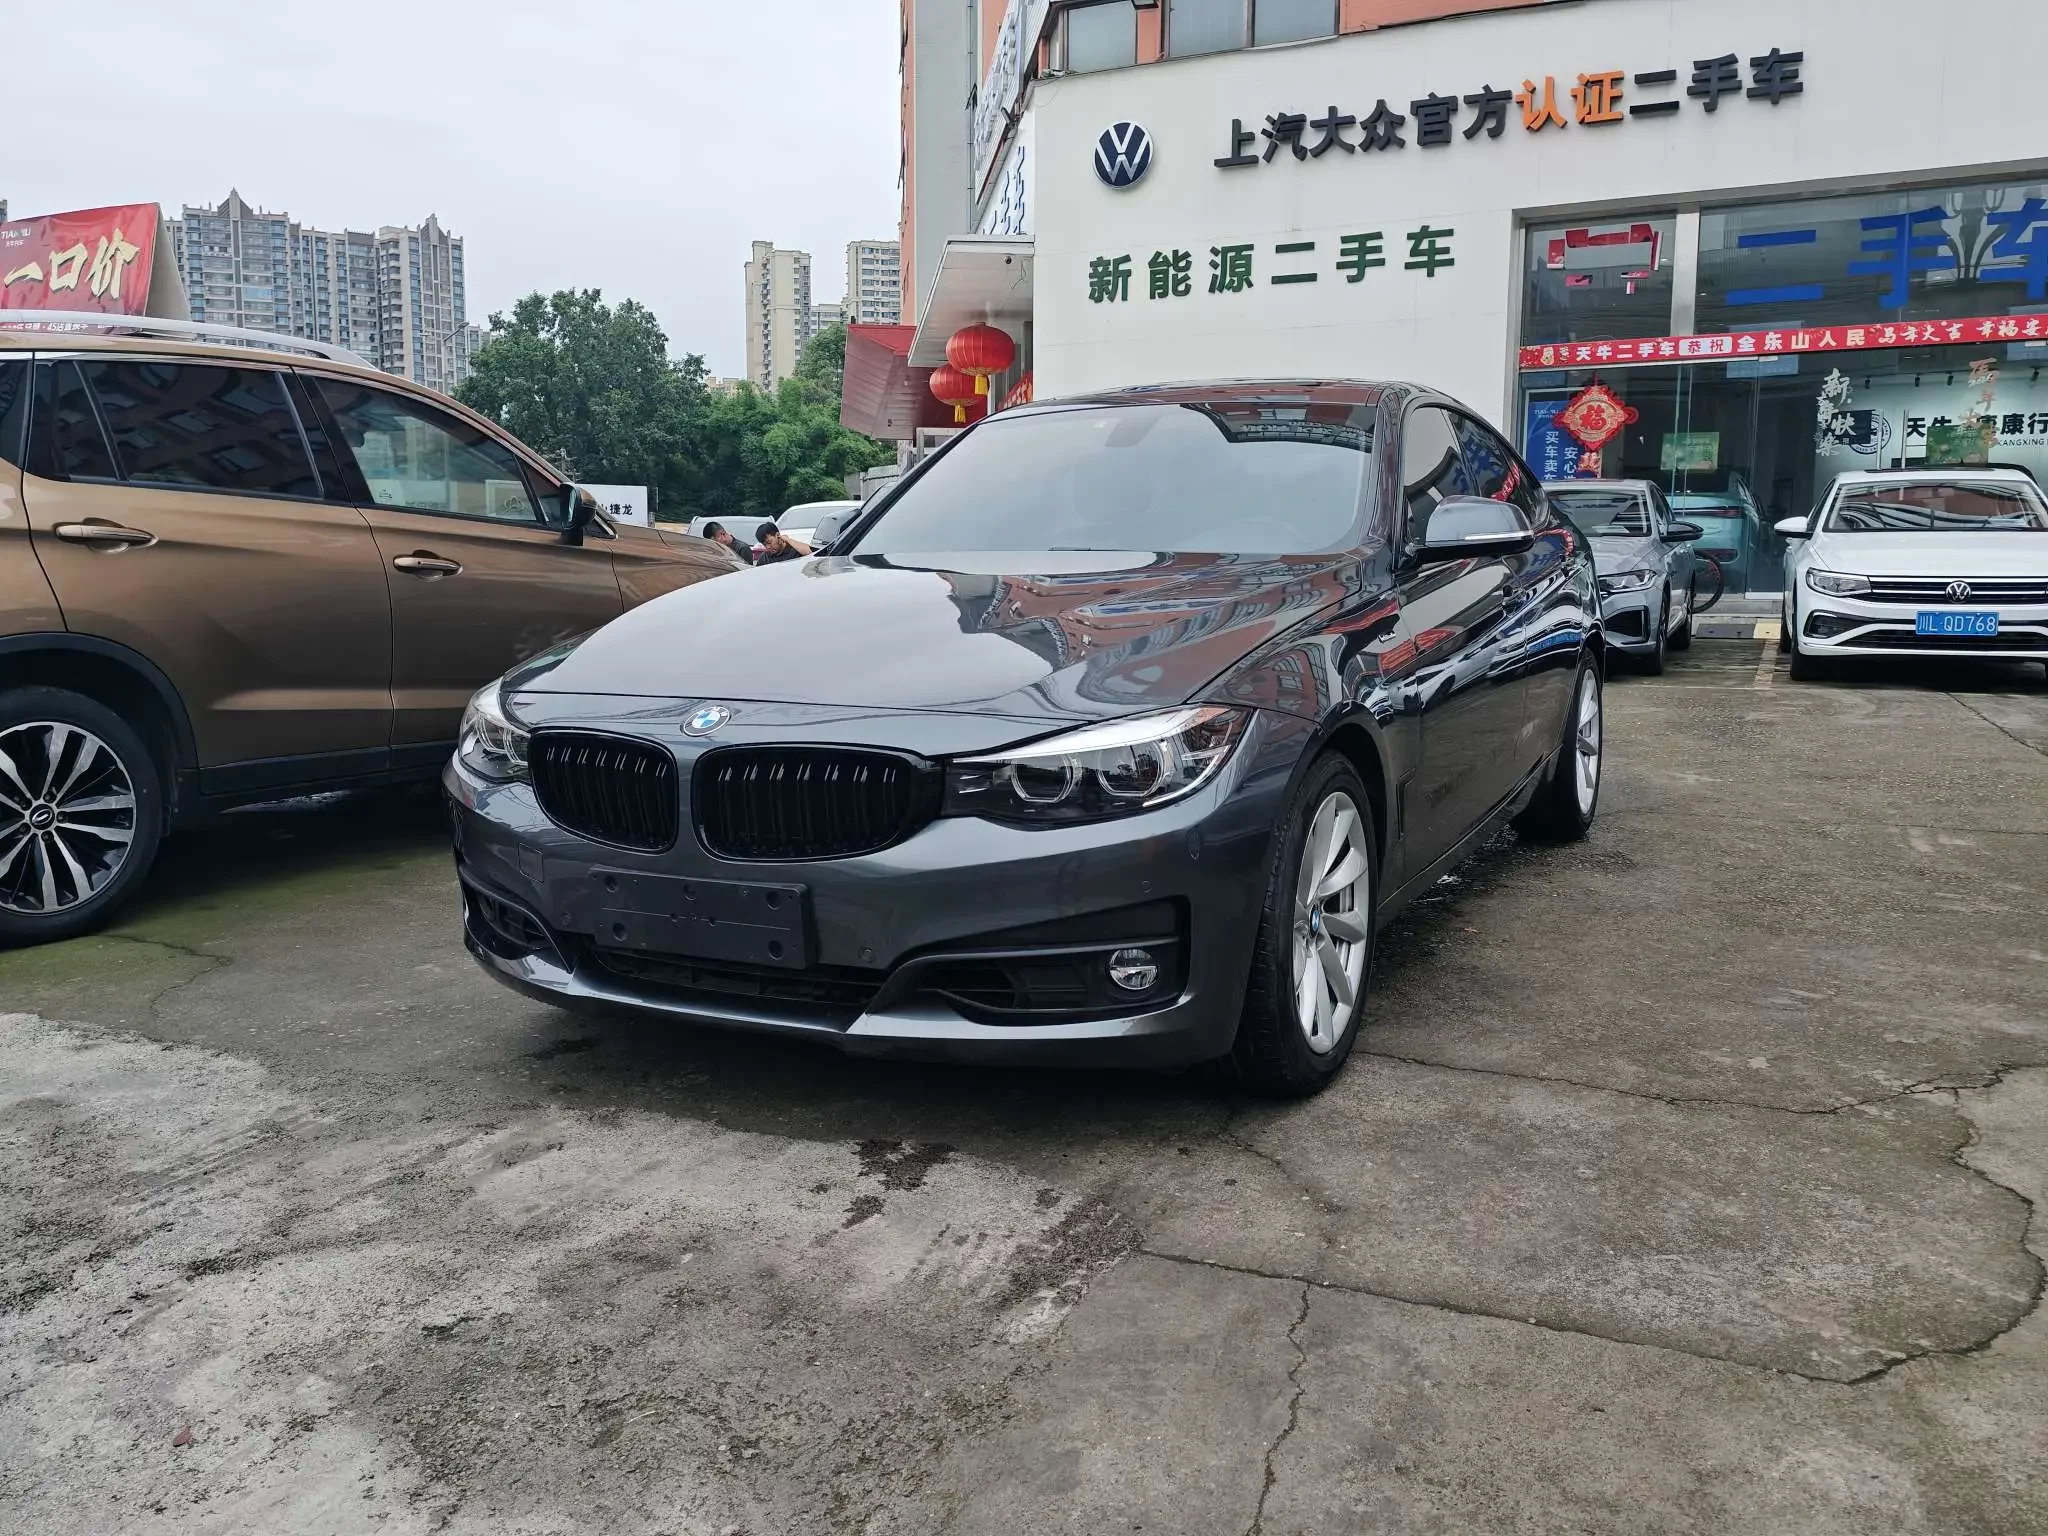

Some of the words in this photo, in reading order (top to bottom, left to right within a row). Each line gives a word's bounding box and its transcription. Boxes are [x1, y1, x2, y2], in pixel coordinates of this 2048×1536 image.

[1214, 47, 1804, 168] 上汽大众官方认证二手车
[3, 227, 140, 299] 一口价
[1088, 225, 1456, 303] 新能源二手车
[1976, 317, 2048, 338] 幸福安
[1580, 404, 1607, 431] 福
[601, 503, 633, 515] 捷龙
